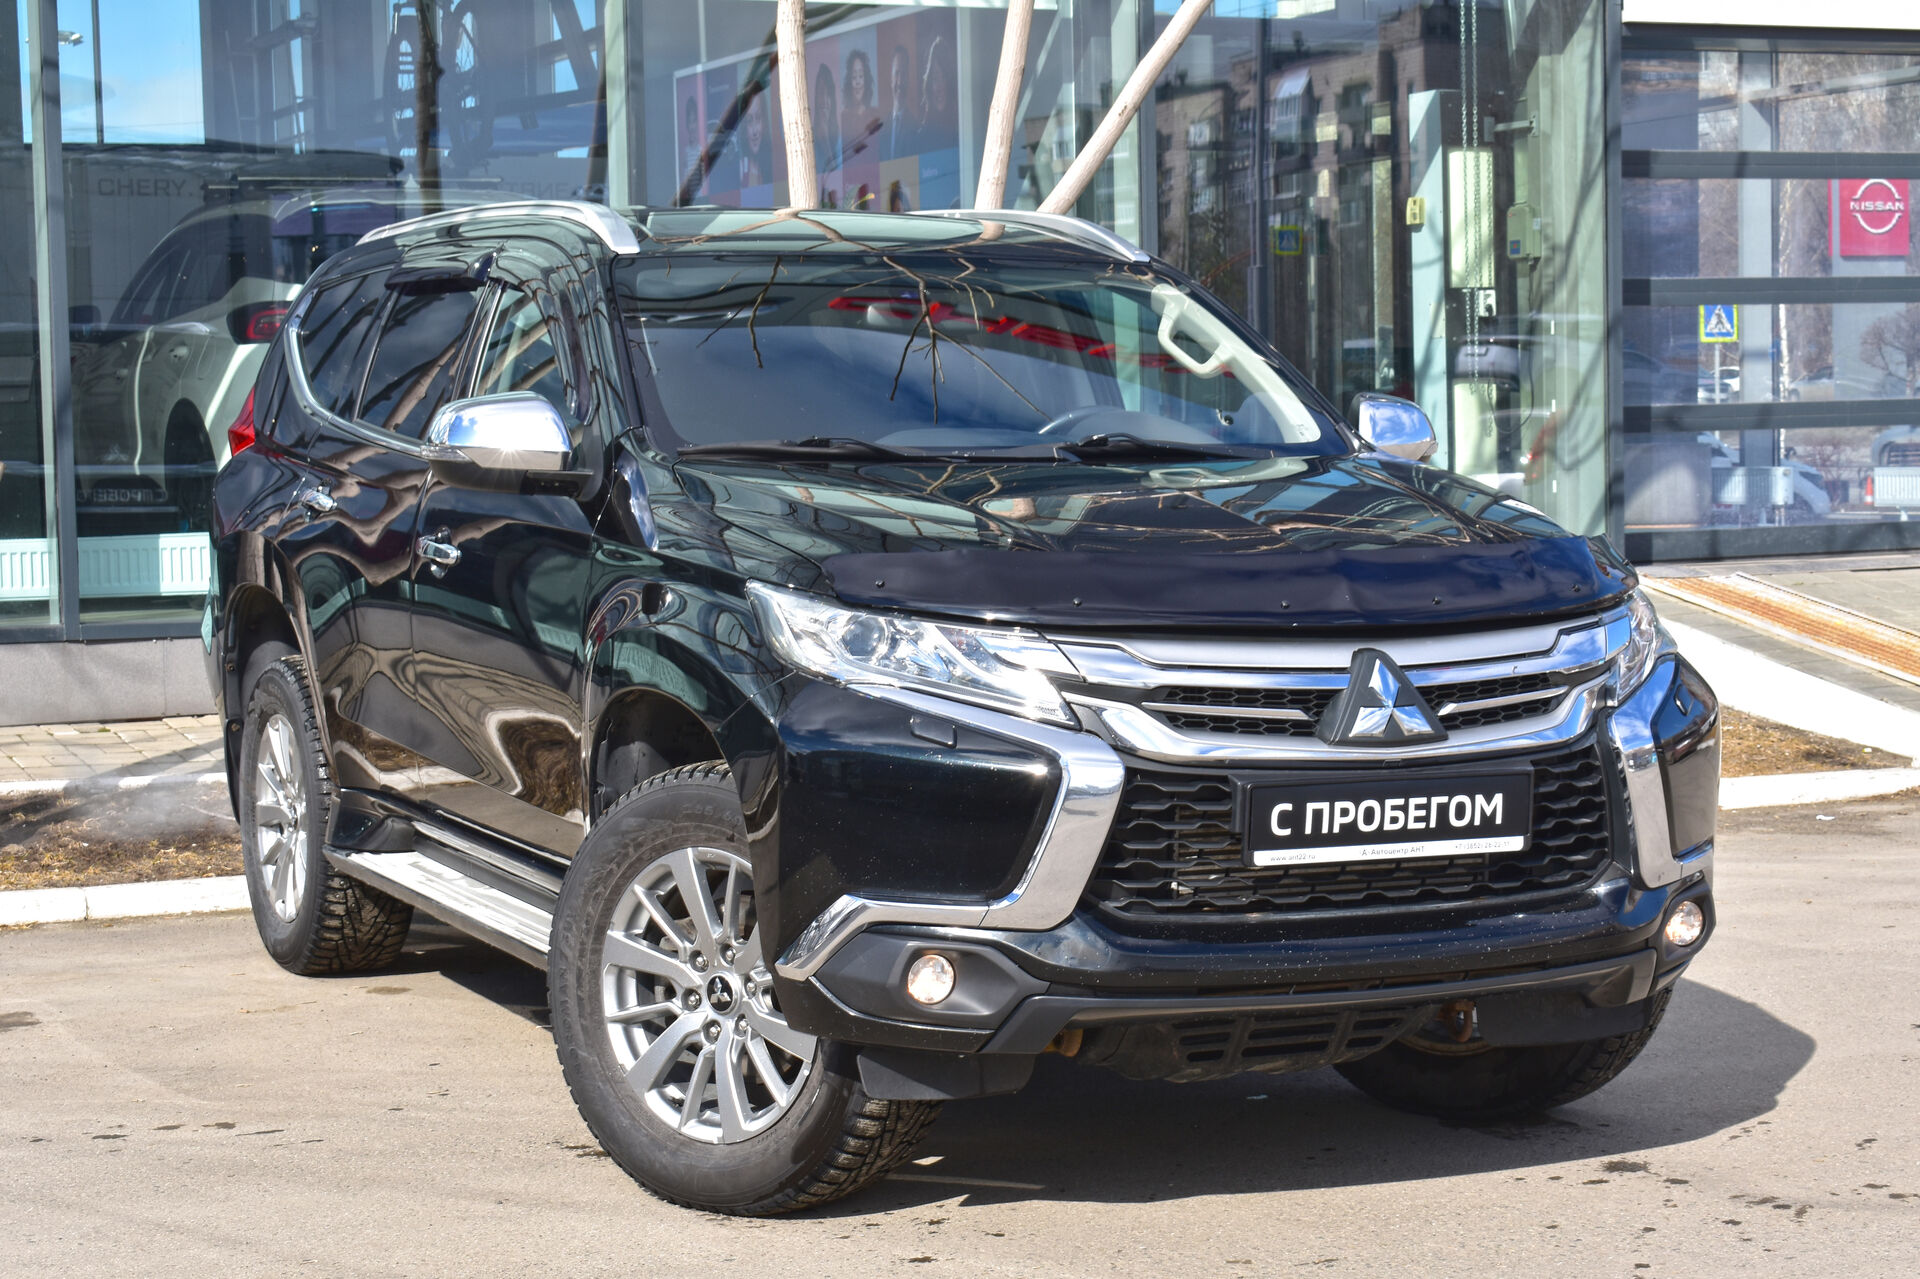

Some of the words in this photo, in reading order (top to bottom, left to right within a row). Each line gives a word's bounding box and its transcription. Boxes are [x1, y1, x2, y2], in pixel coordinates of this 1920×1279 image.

[1849, 201, 1904, 211] NISSAN
[1270, 803, 1293, 836] С
[1304, 793, 1503, 835] ПРОБЕГОМ
